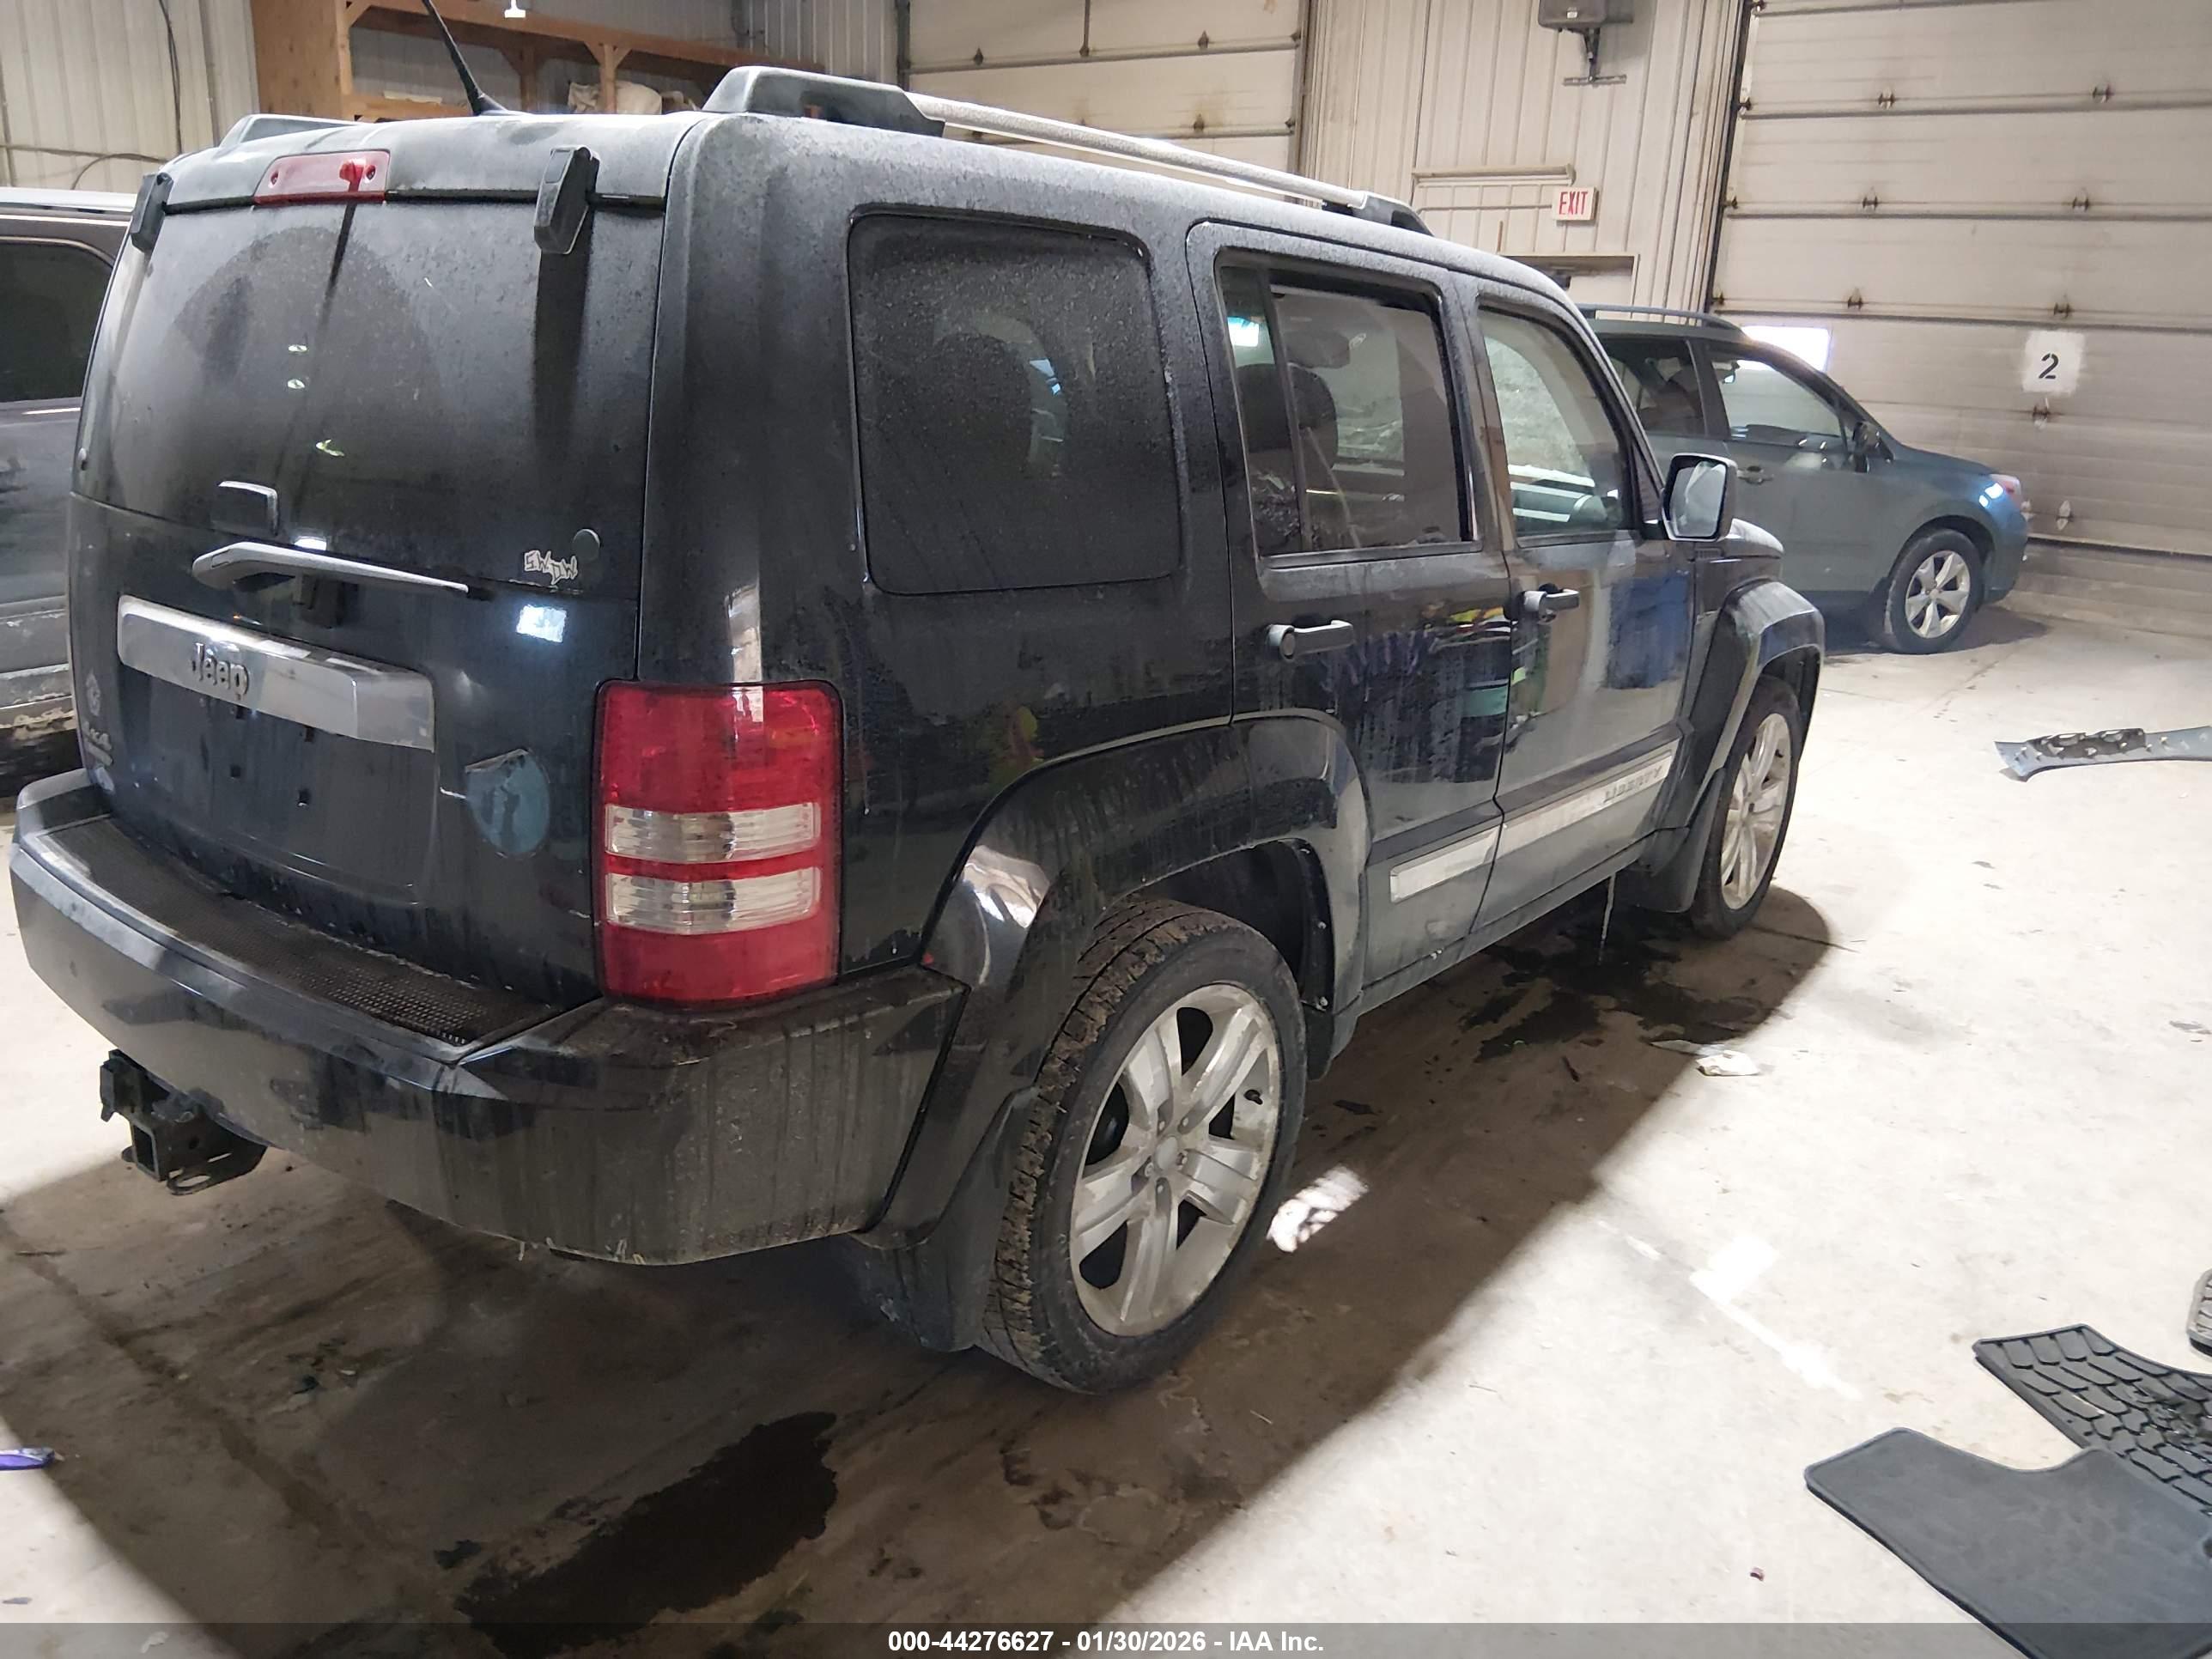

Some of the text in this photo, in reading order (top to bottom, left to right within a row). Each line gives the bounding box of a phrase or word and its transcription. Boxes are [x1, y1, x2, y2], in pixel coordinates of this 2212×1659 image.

[1559, 191, 1589, 216] EXIT
[2039, 353, 2059, 380] 2
[192, 642, 249, 701] Jeep
